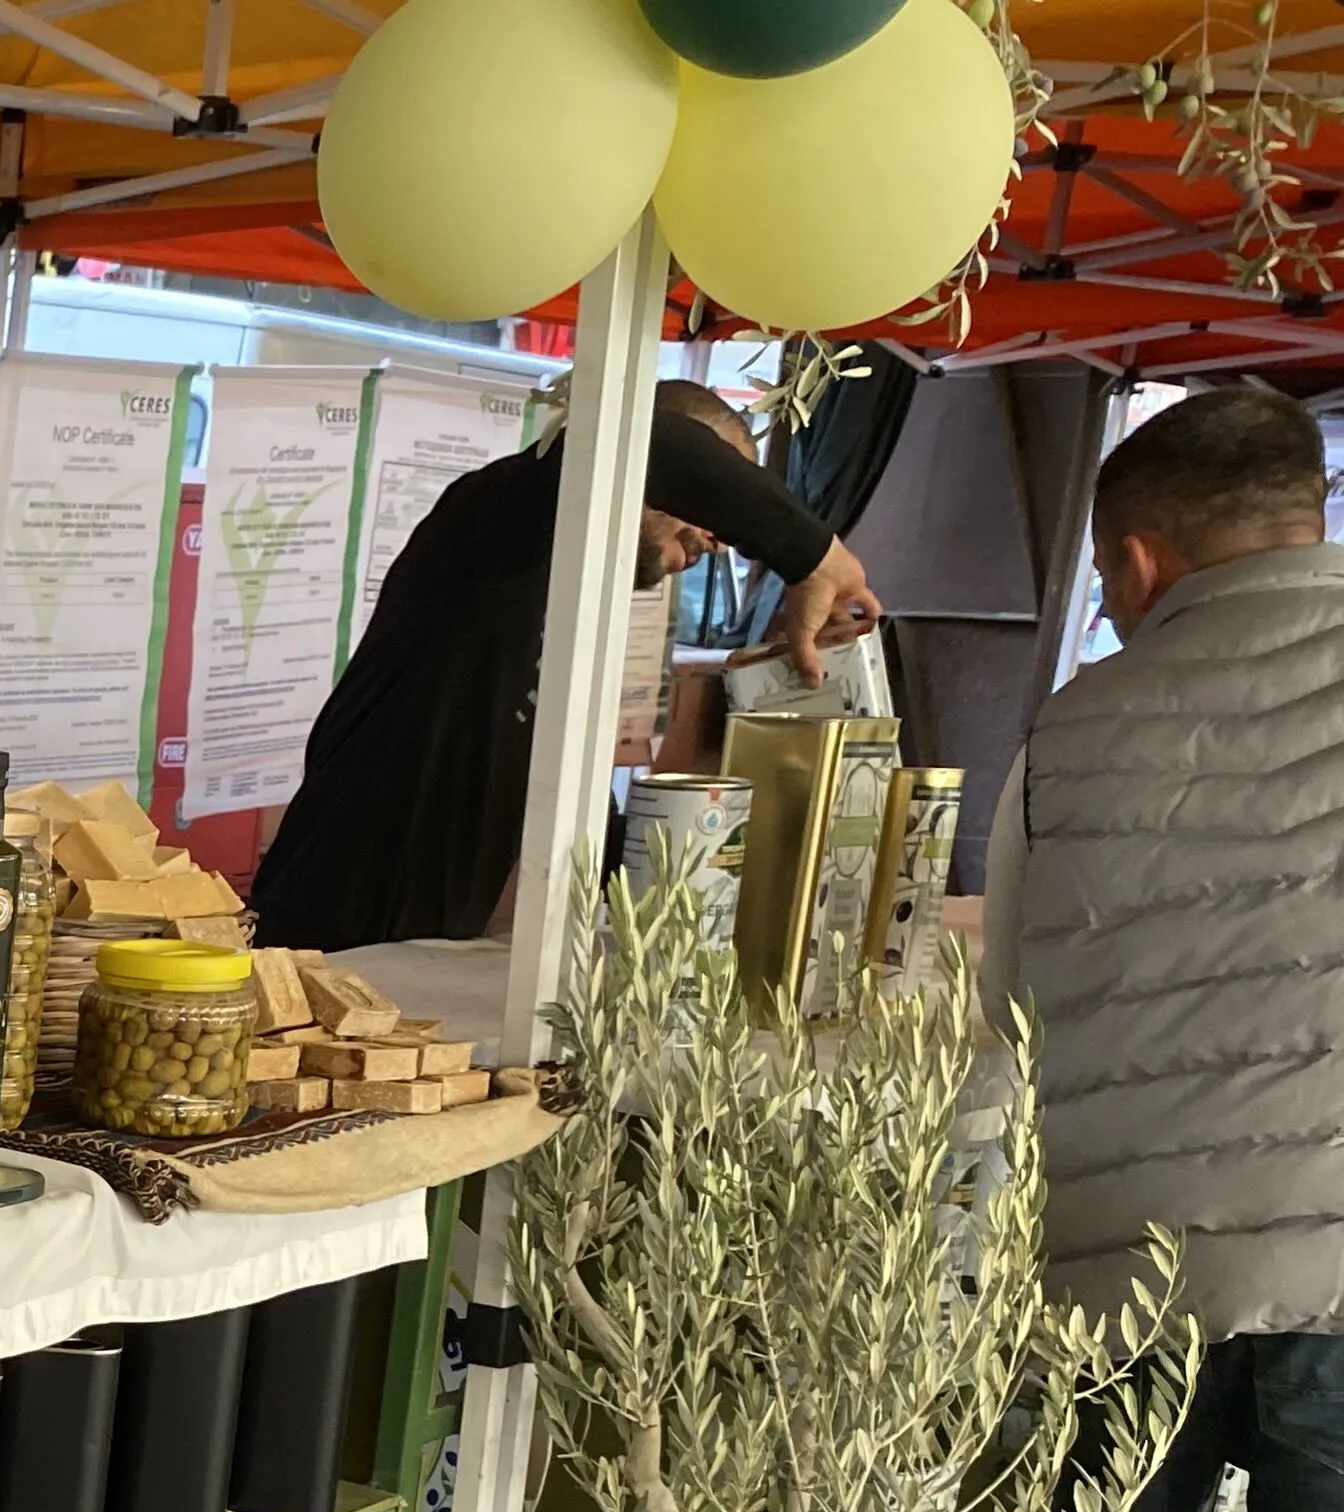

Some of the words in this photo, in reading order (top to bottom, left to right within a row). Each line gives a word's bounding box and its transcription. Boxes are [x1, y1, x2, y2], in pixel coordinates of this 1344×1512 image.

[130, 396, 171, 414] CERES
[325, 407, 357, 423] CERES
[52, 425, 81, 444] NOP
[82, 427, 135, 446] Certificate
[269, 445, 316, 462] Certificate
[163, 744, 185, 760] FIRE
